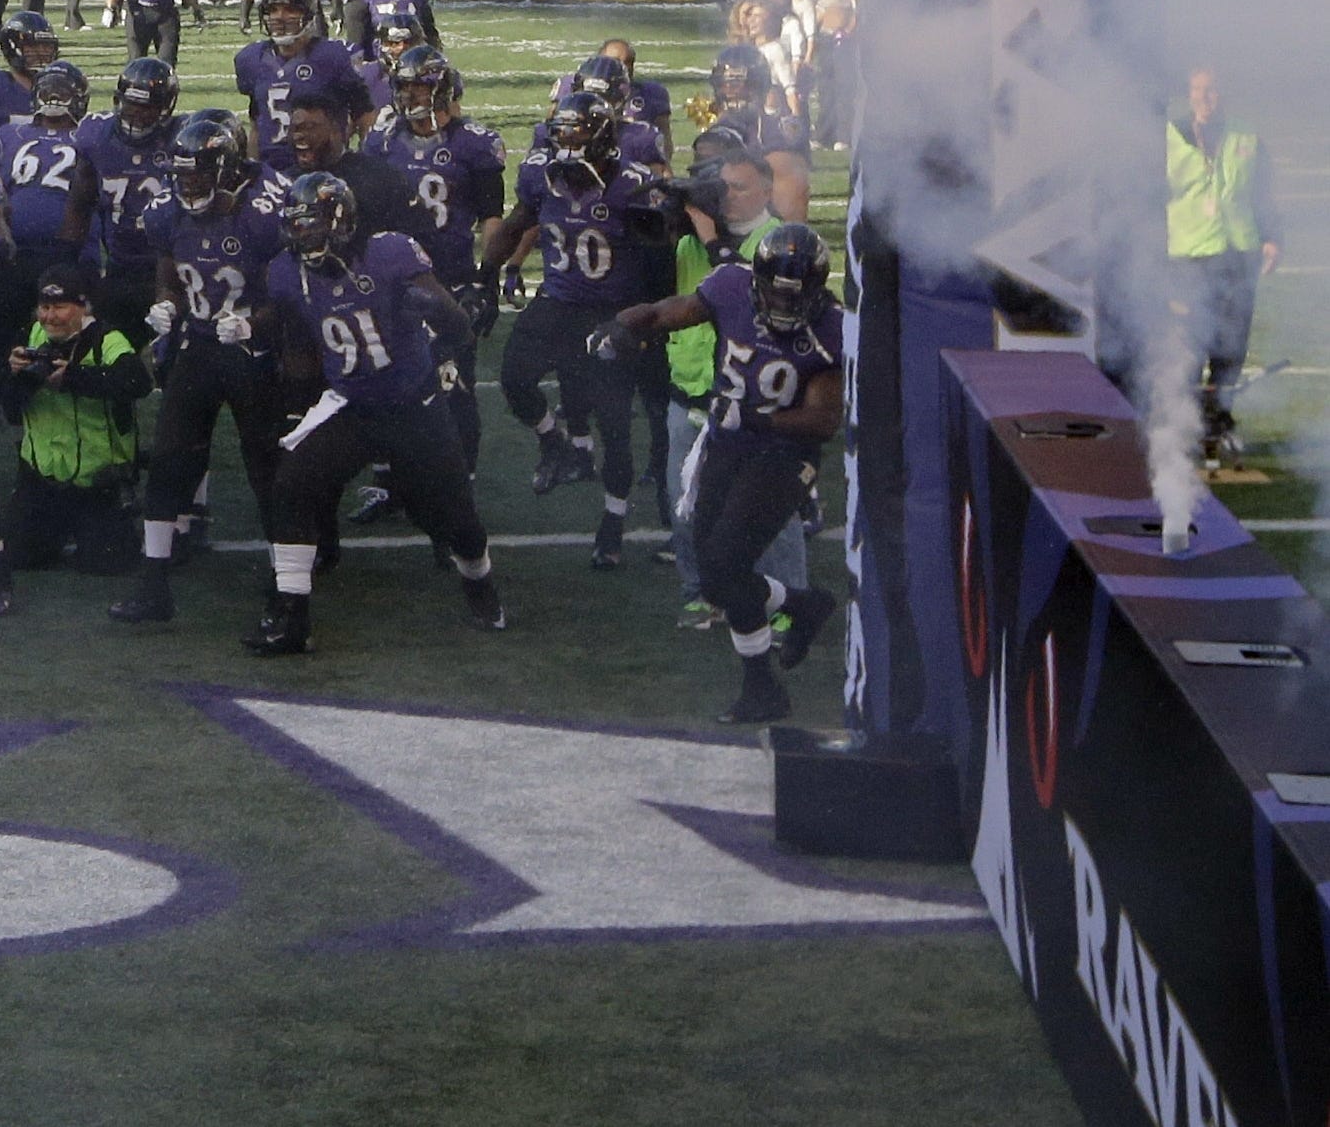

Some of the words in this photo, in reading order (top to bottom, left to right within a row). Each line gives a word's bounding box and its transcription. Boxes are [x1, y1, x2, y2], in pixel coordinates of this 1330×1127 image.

[11, 140, 77, 191] 62
[321, 309, 391, 375] 91
[720, 339, 798, 414] 59
